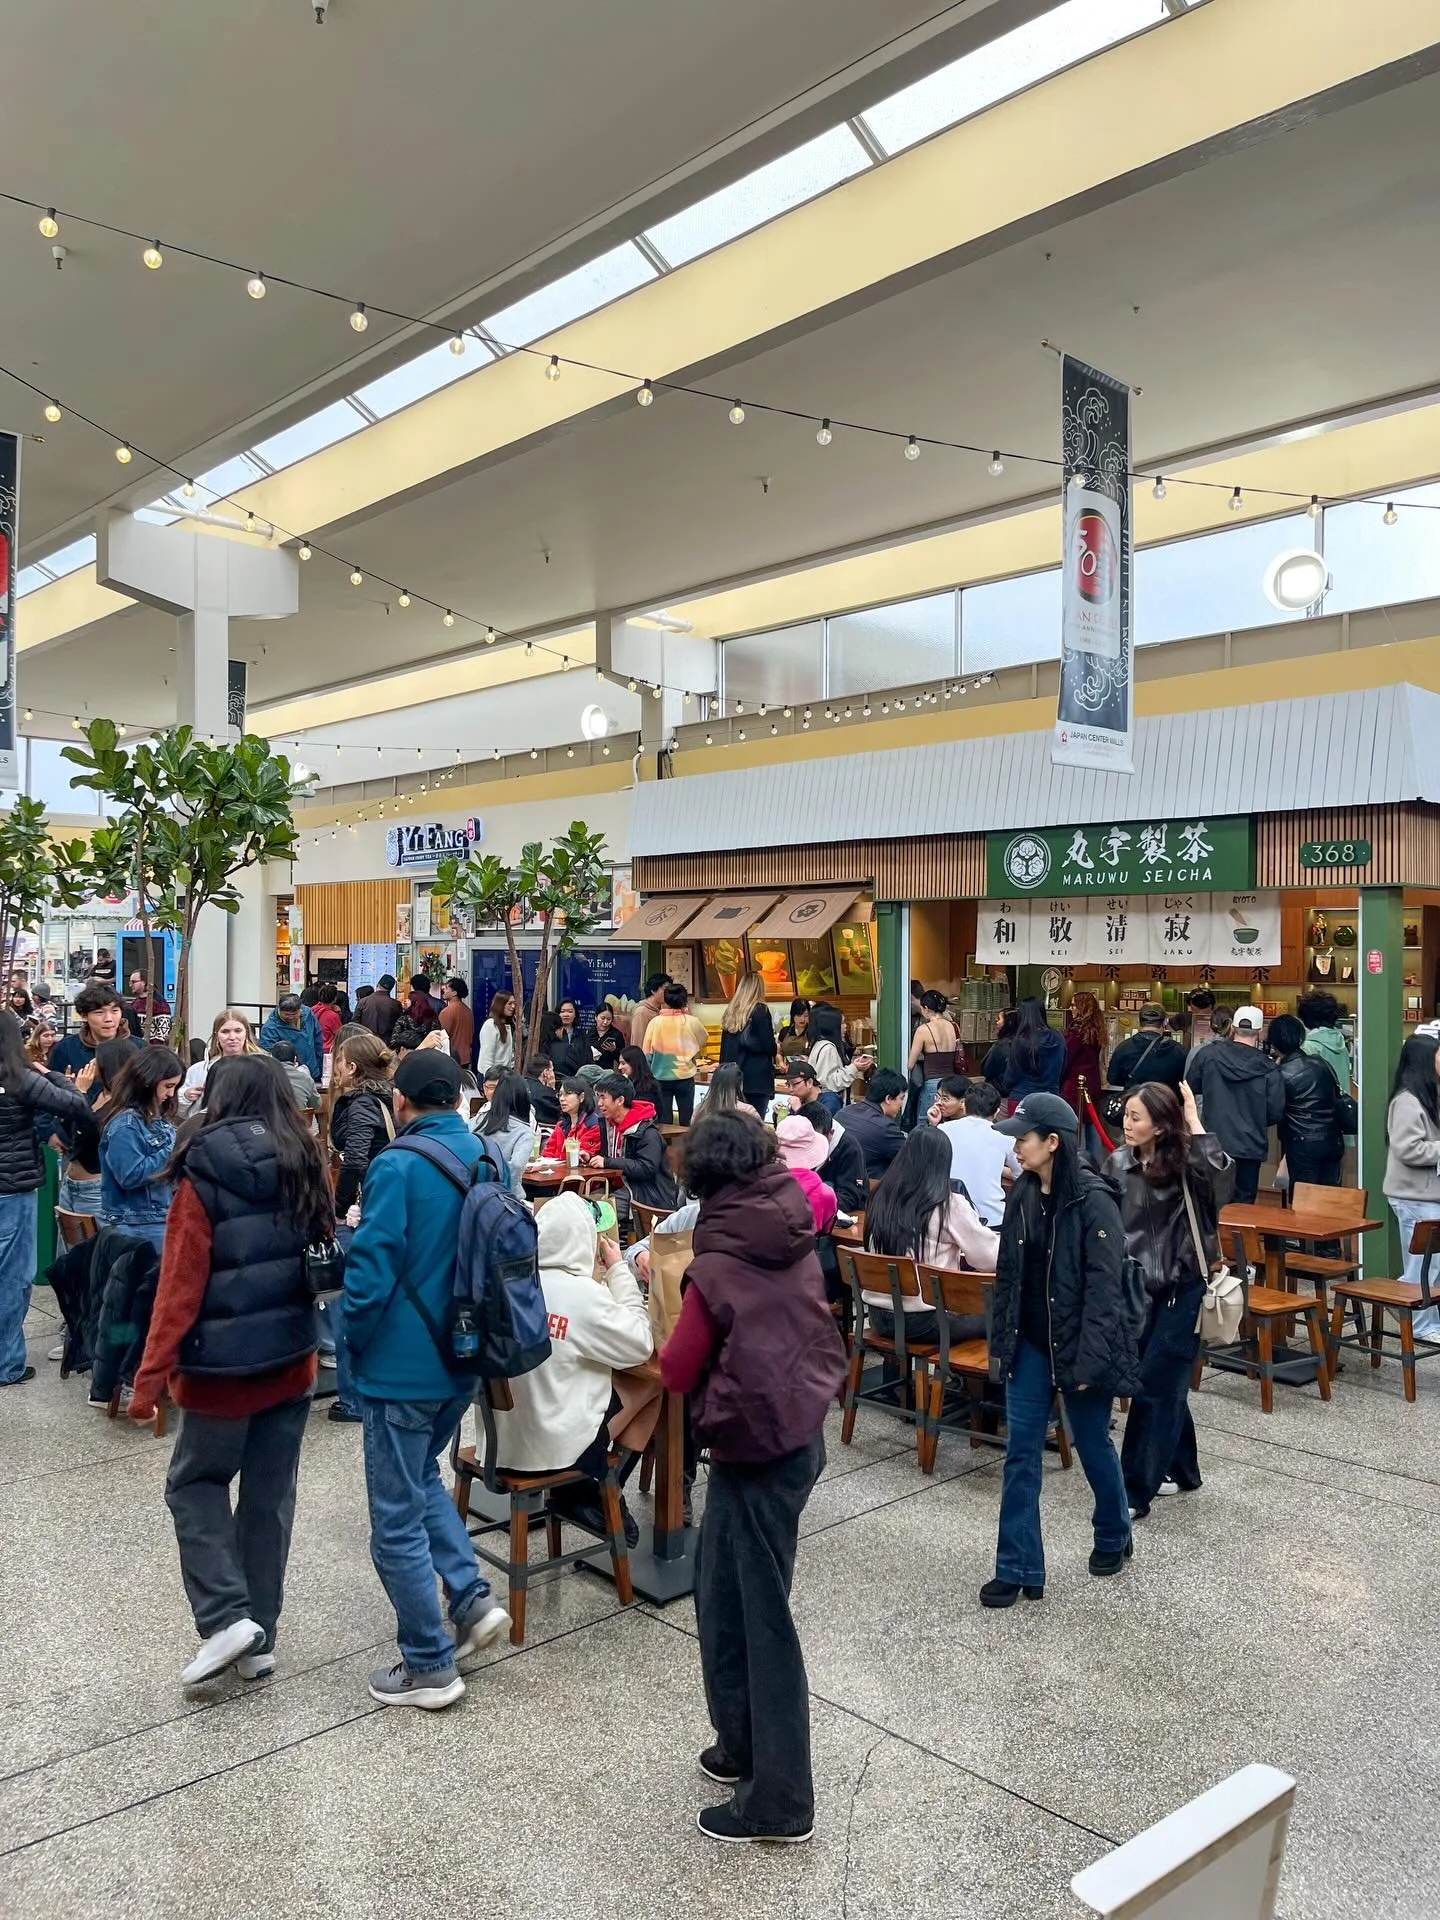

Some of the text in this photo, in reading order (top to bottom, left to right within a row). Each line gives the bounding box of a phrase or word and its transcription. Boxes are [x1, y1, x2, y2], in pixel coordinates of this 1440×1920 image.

[424, 823, 464, 850] FANG
[1311, 844, 1355, 863] 368
[1062, 867, 1213, 886] MARUWU SEICHA
[1000, 902, 1011, 913] わ
[1049, 901, 1071, 912] けい
[1106, 898, 1128, 910] せい
[1164, 896, 1193, 909] じゃく
[993, 918, 1016, 943] 和
[1049, 916, 1072, 943] 敬
[1106, 914, 1128, 942] 清
[1164, 913, 1191, 942] 寂
[545, 1312, 568, 1340] ER
